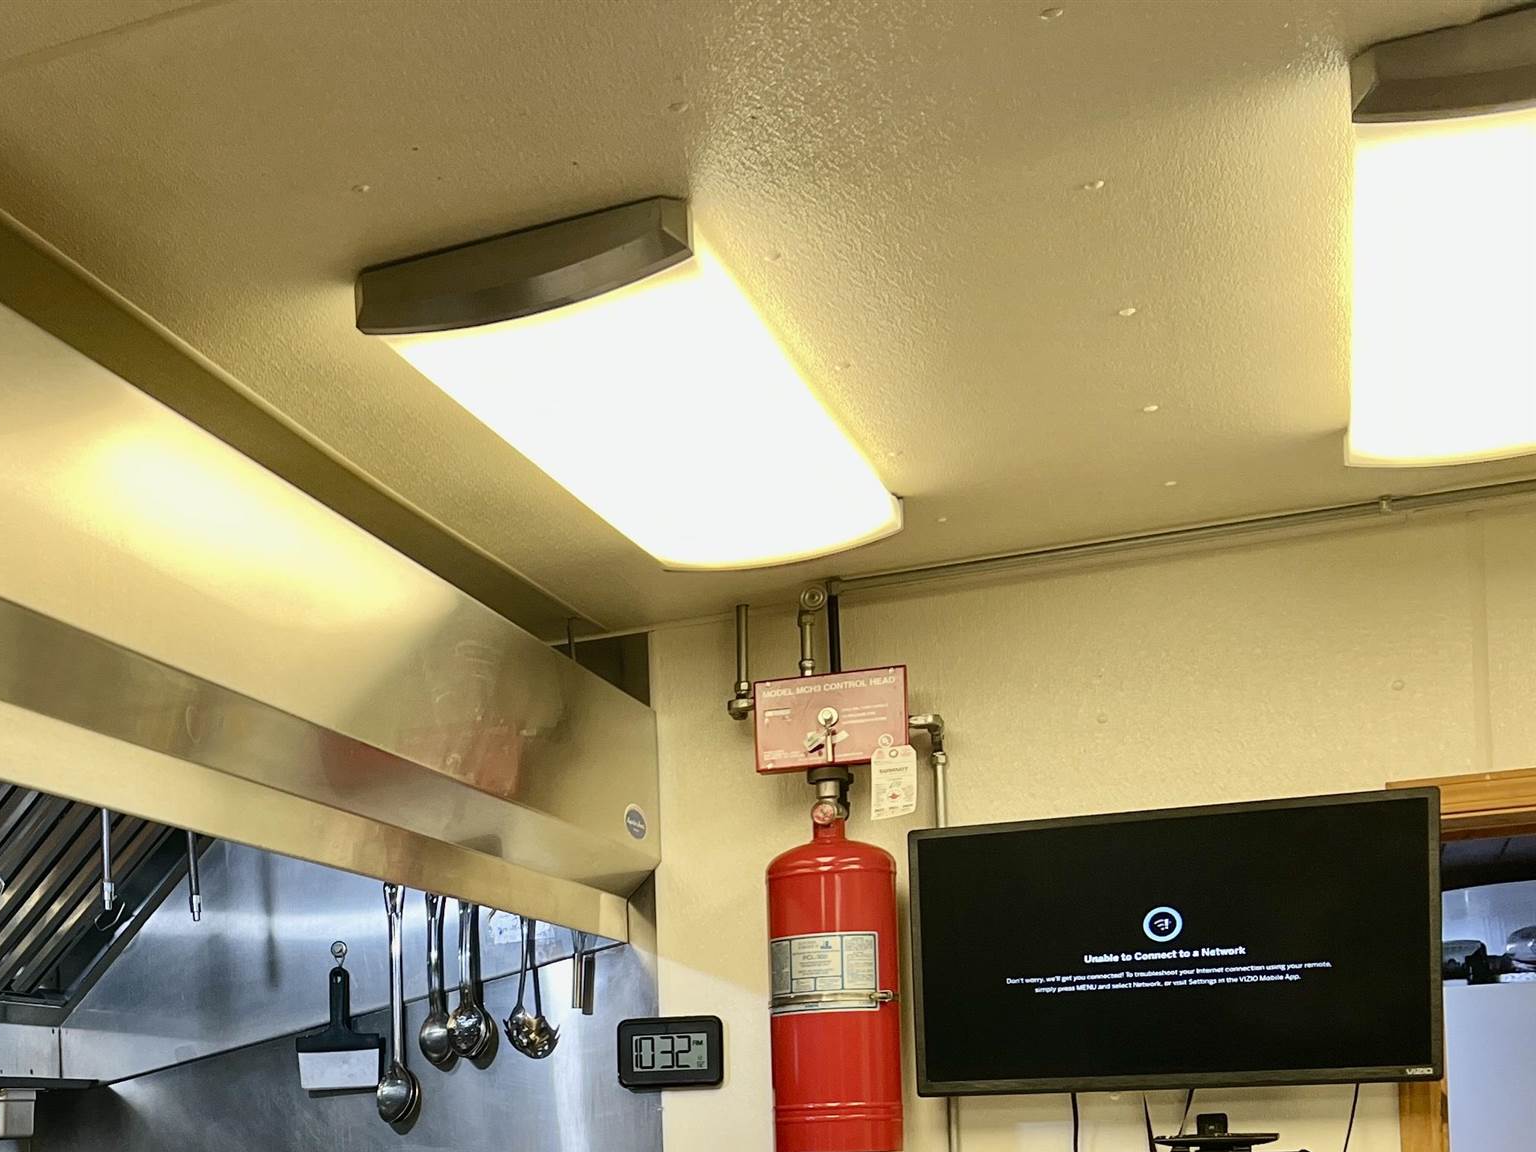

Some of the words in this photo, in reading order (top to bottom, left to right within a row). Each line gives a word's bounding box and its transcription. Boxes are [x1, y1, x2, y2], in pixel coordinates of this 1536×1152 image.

[762, 689, 794, 698] MODEL
[824, 680, 867, 692] CONTROL
[869, 676, 896, 686] HEAD
[1083, 953, 1120, 964] Unable
[1120, 952, 1133, 962] to
[1134, 949, 1177, 961] Connect
[1179, 948, 1191, 959] to
[1192, 950, 1200, 958] a
[1201, 946, 1246, 957] Network
[1061, 975, 1073, 983] get
[1134, 969, 1178, 978] troubleshoot
[1225, 965, 1265, 973] connection
[1188, 978, 1217, 986] Settings
[1405, 1067, 1434, 1075] VIZIO
